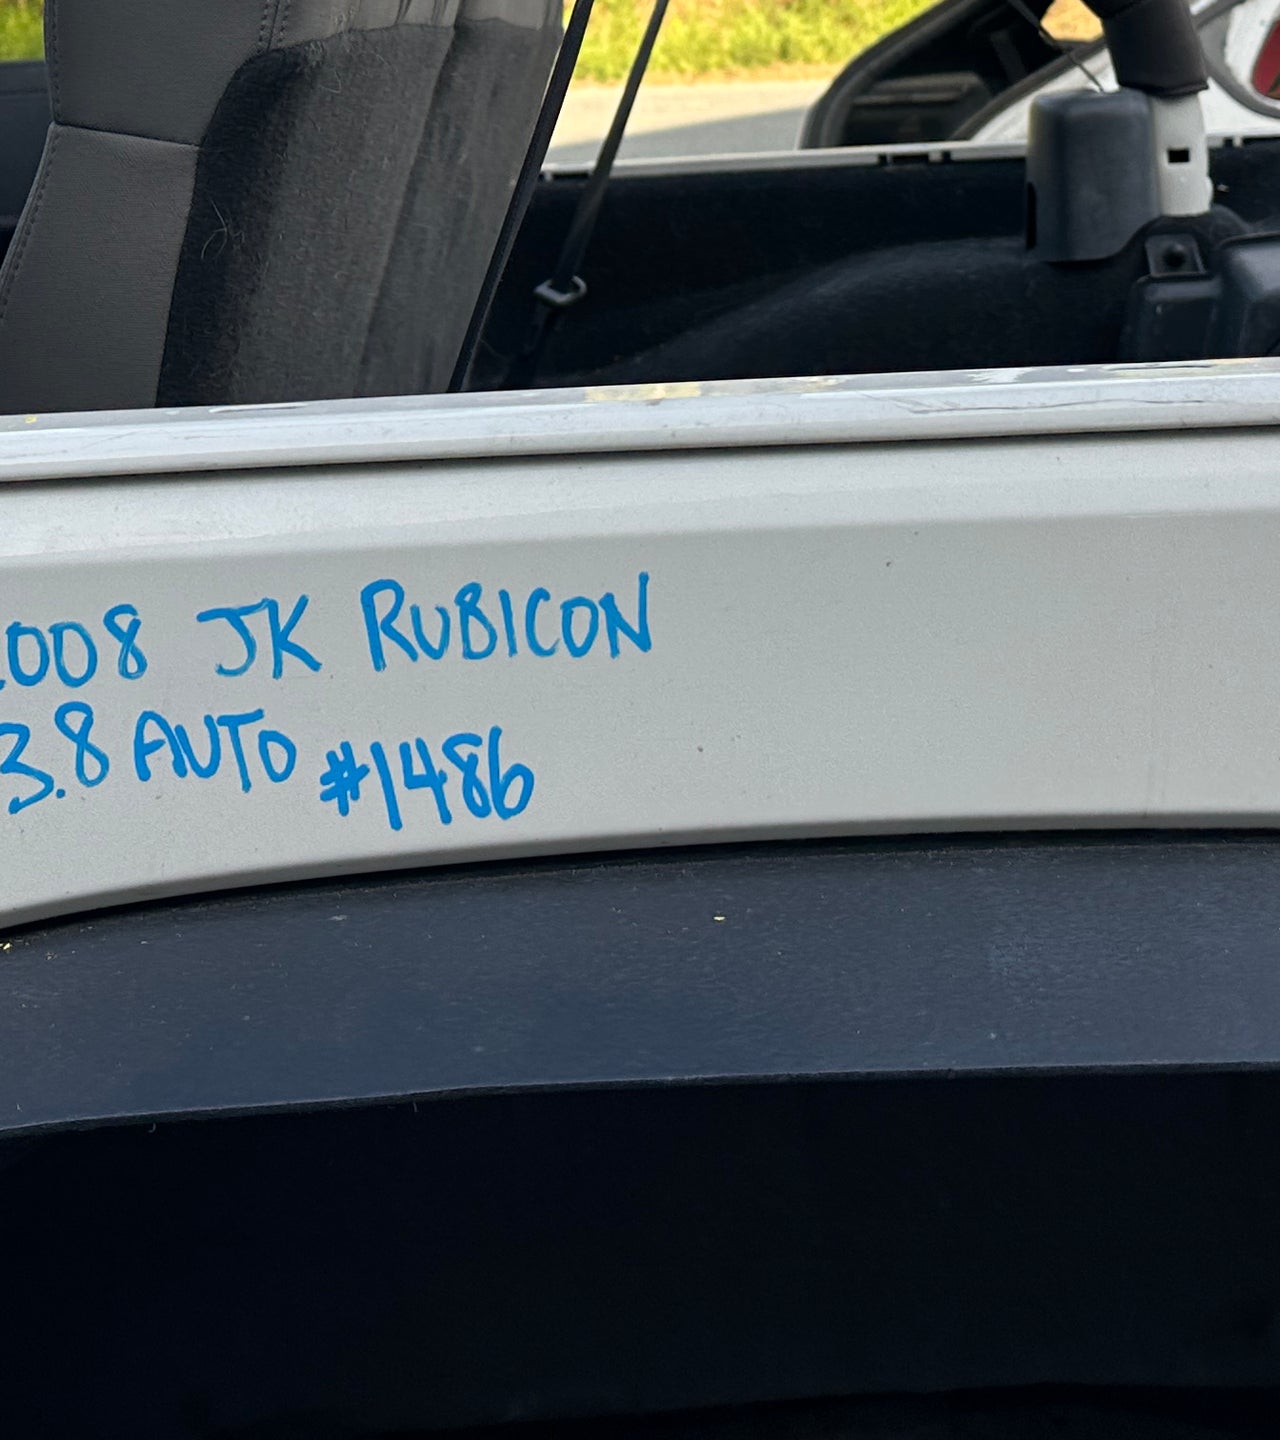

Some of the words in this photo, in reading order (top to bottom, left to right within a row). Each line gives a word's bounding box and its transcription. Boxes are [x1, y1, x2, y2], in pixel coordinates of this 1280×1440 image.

[196, 595, 322, 680] JK
[360, 571, 653, 672] RUBICON
[132, 708, 298, 793] AUTO
[319, 725, 536, 831] #1486
